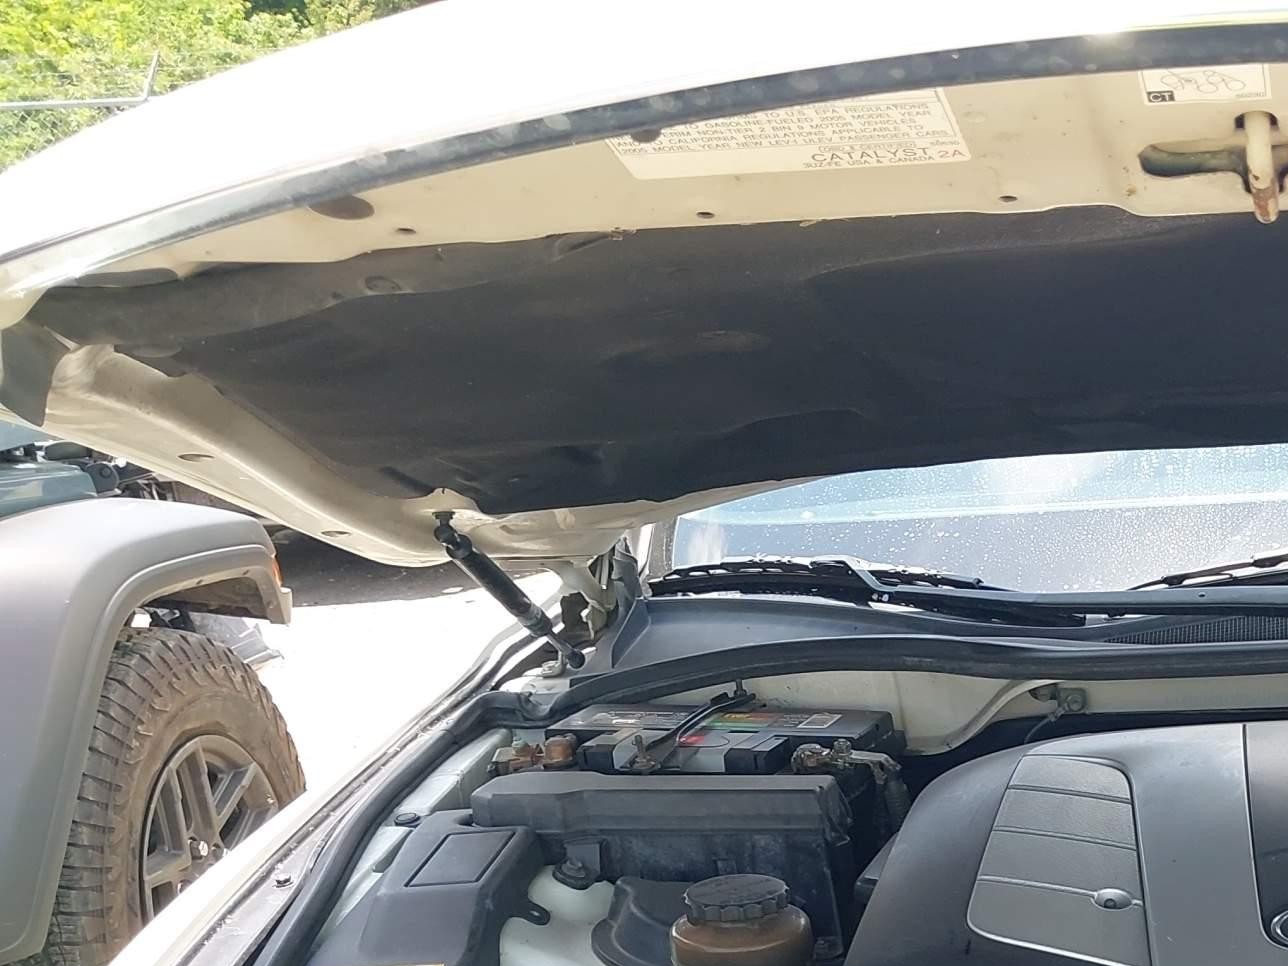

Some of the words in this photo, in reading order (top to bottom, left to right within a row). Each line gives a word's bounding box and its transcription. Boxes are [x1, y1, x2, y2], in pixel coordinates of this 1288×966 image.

[1150, 92, 1171, 102] CT
[811, 147, 929, 163] CATALYST
[889, 155, 935, 164] CANADA
